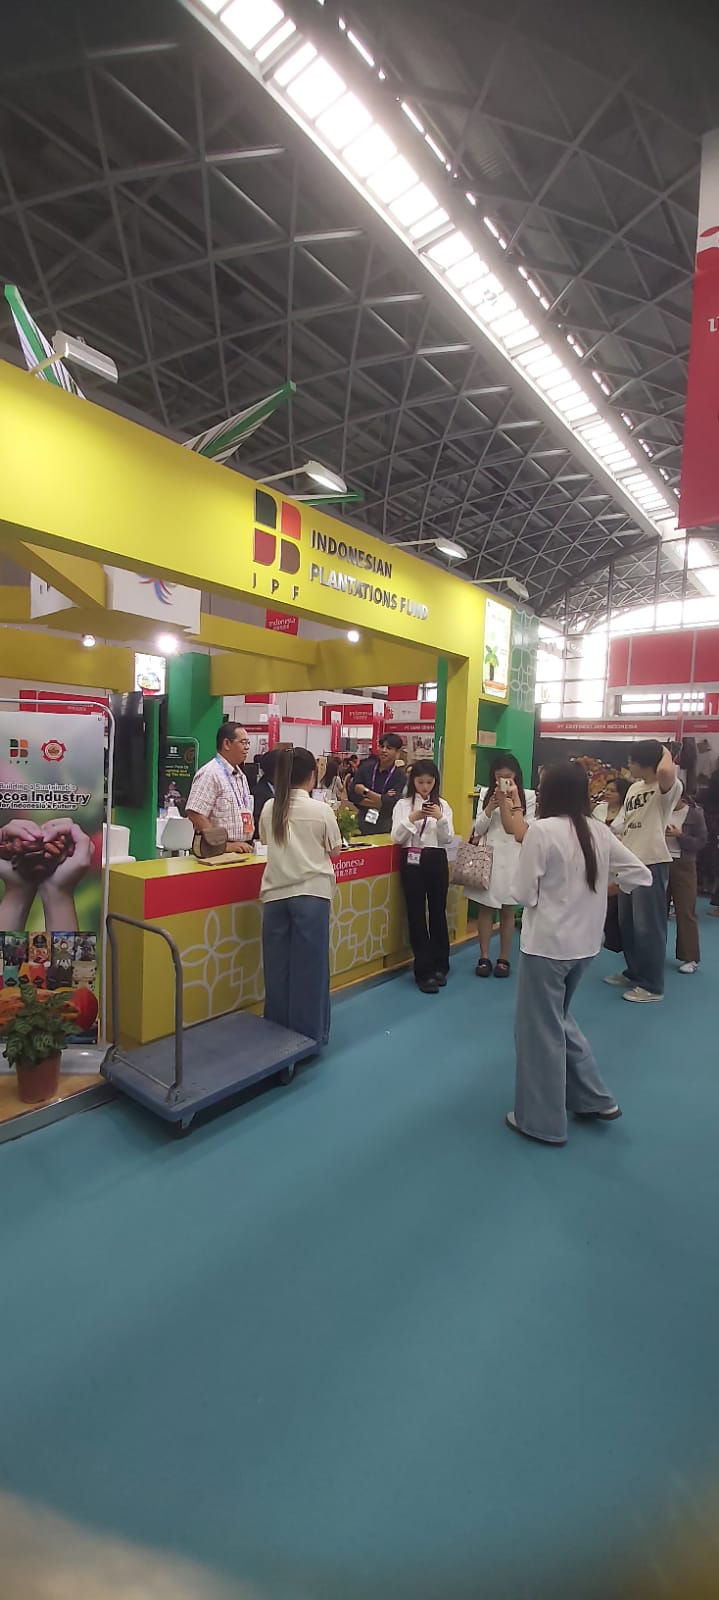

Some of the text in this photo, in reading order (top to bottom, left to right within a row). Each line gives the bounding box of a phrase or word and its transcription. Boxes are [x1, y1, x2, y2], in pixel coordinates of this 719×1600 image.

[311, 529, 393, 579] INDONESIAN
[310, 563, 429, 621] PLANTATIONS FUND
[32, 790, 90, 805] Industry
